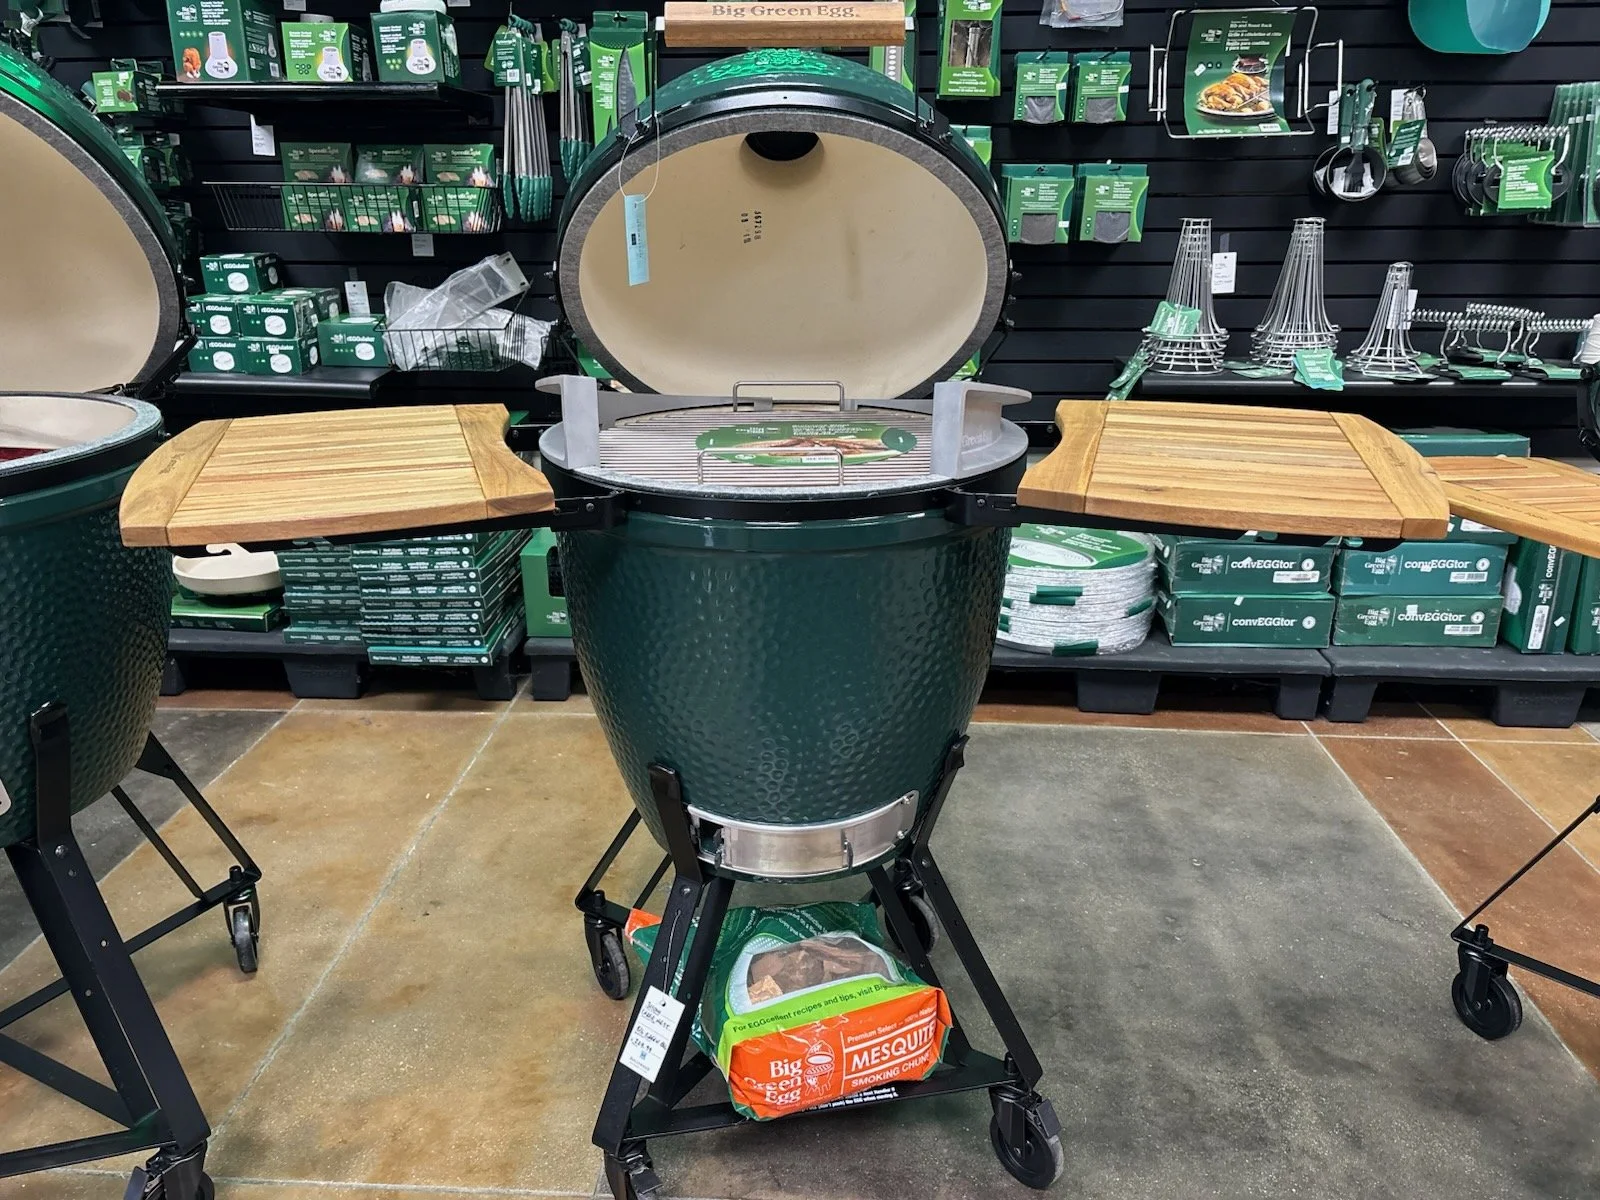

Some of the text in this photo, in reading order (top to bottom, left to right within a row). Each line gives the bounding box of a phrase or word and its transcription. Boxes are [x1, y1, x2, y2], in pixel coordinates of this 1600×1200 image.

[712, 5, 745, 18] Big
[750, 5, 812, 16] Green
[1230, 558, 1295, 569] convEGGtor
[1404, 559, 1470, 569] convEGGtor
[1232, 617, 1296, 627] convEGGtor
[1398, 612, 1464, 622] convEGGtor
[732, 1025, 746, 1033] For
[748, 1012, 792, 1028] EGGcellent
[793, 1002, 824, 1018] recipes
[824, 996, 839, 1007] and
[840, 993, 857, 1004] tips,
[858, 986, 874, 997] visit
[848, 1030, 877, 1044] Premium
[877, 1022, 898, 1034] Select
[851, 1020, 936, 1072] MESQUITE
[770, 1058, 802, 1078] Big
[851, 1066, 900, 1087] SMOKING
[764, 1088, 802, 1105] Egg
